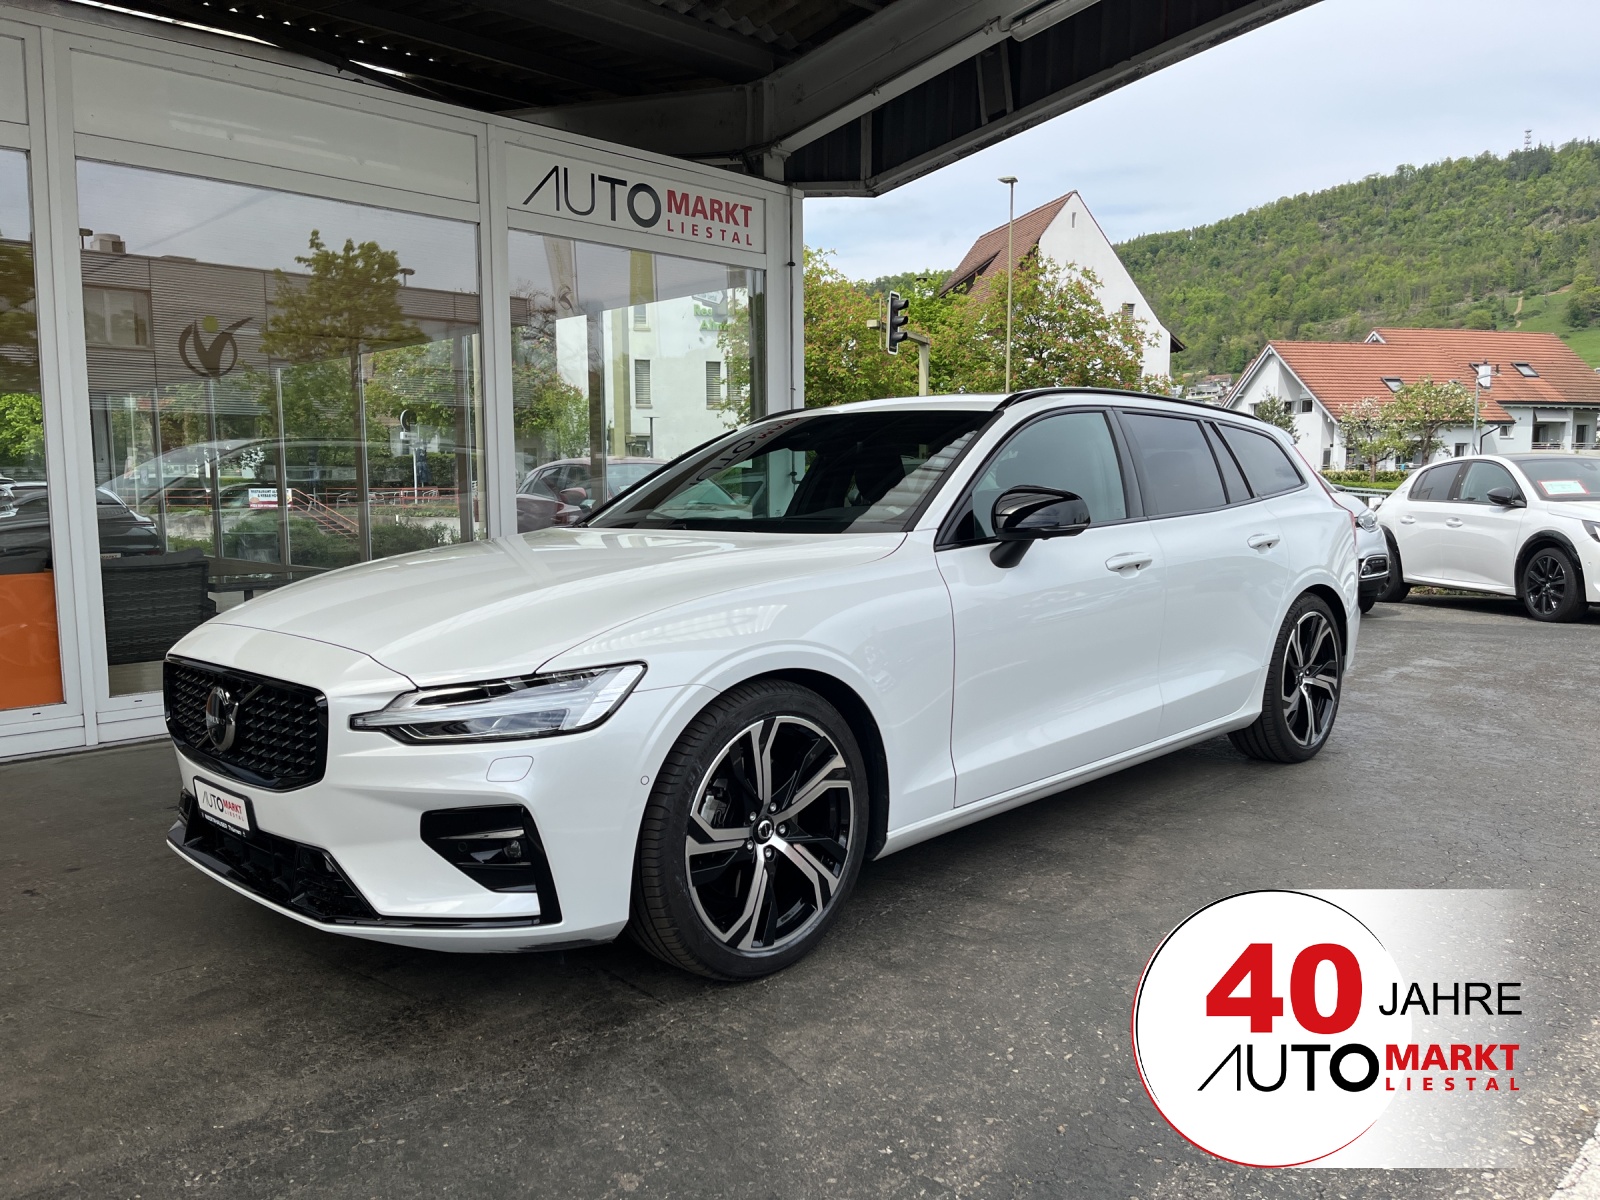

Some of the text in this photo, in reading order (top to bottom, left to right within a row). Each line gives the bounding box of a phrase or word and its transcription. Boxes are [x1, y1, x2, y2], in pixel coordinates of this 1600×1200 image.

[522, 165, 753, 228] AUTO MARKT
[666, 219, 753, 246] LIESTAL
[202, 790, 242, 814] AUTO MARKT
